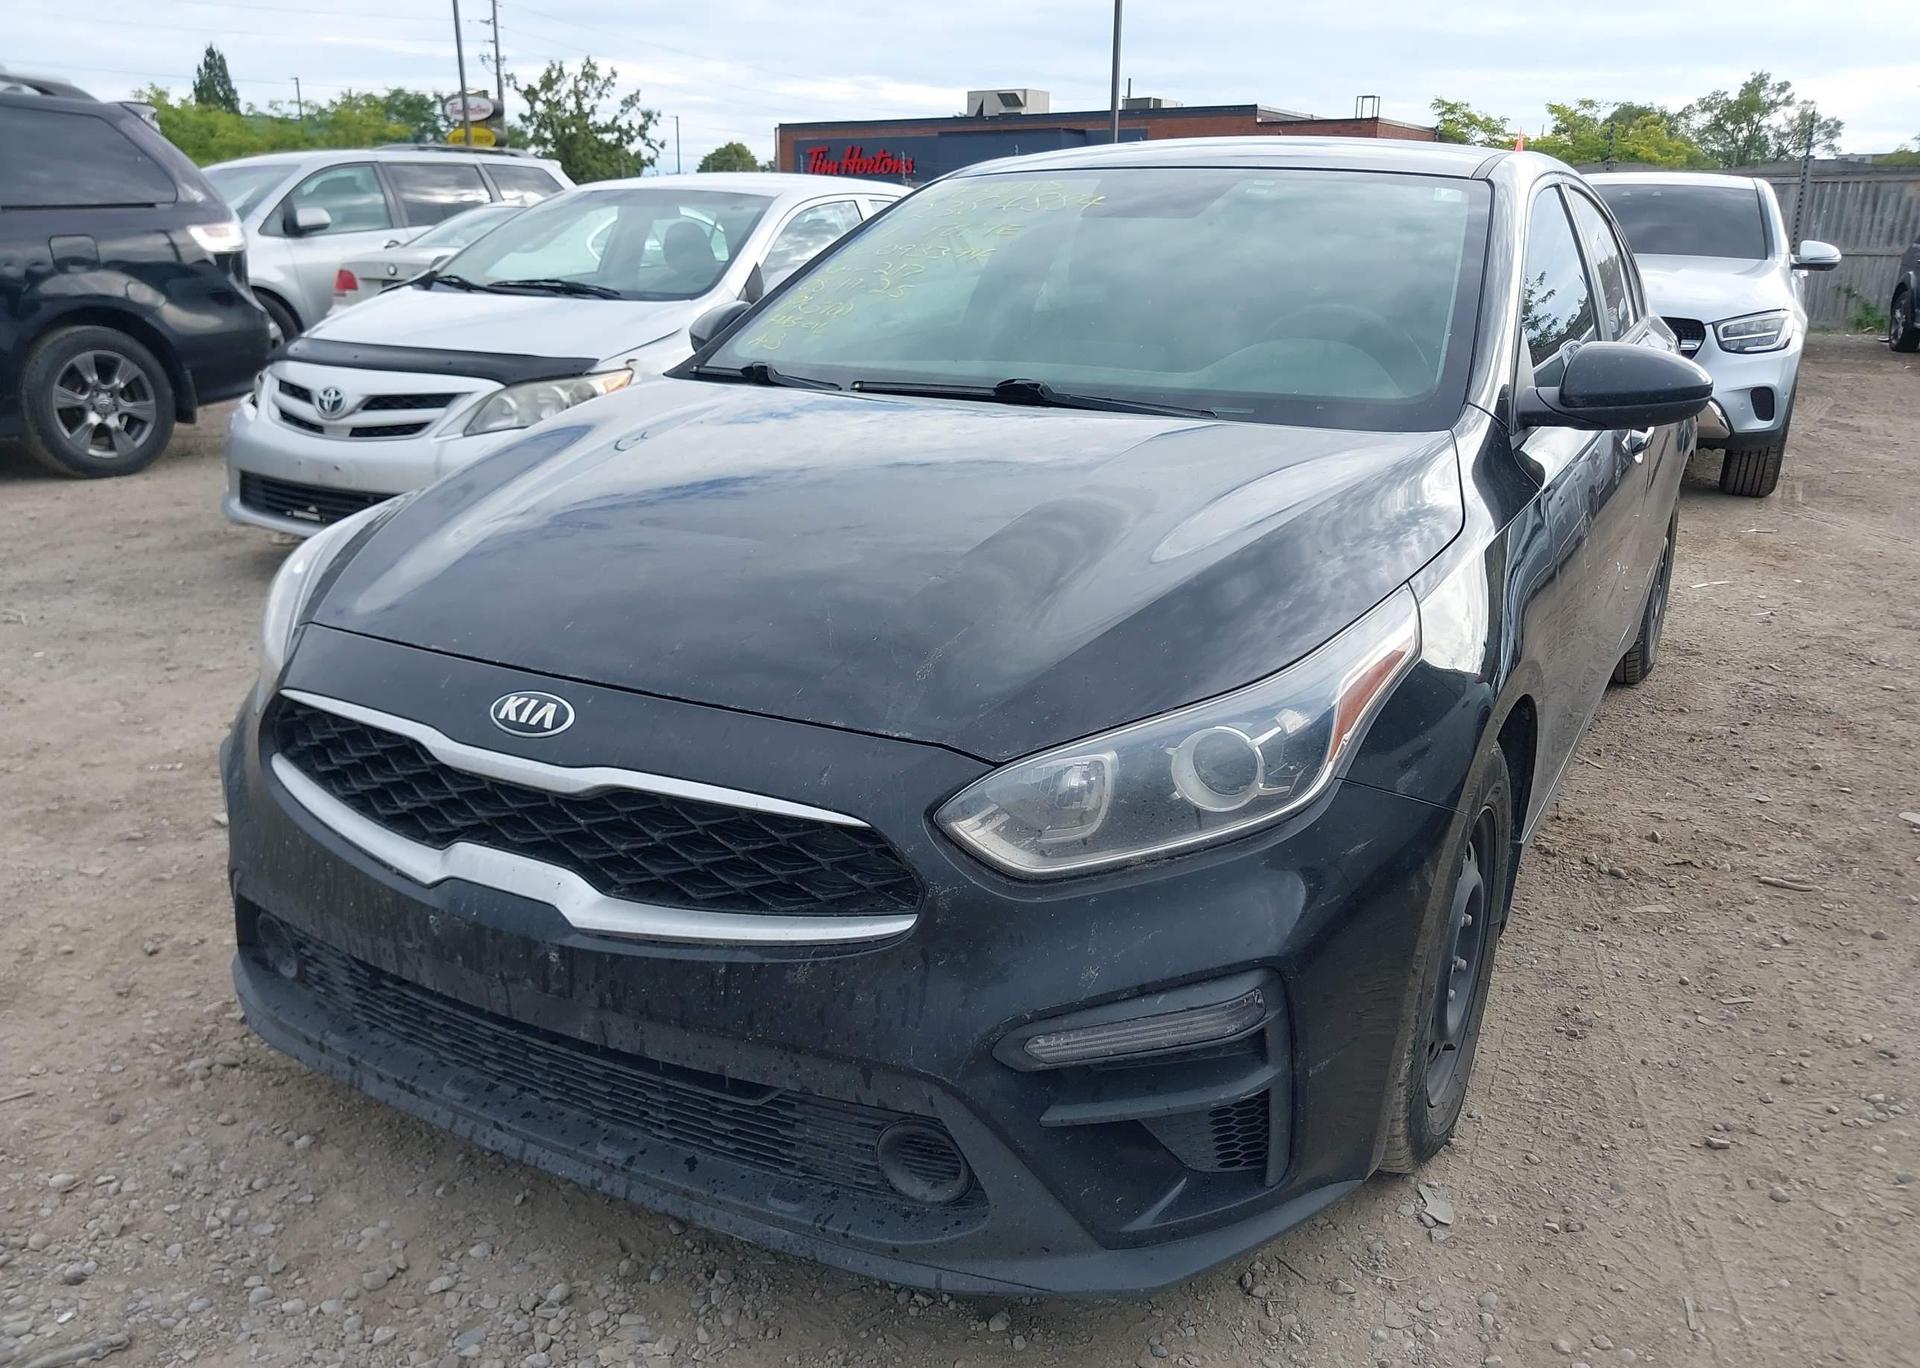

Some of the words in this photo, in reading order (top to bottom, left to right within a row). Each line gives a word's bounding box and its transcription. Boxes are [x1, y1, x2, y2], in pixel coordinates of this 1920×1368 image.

[806, 145, 840, 175] Tim
[840, 144, 914, 175] Hortons
[497, 695, 558, 730] KIA
